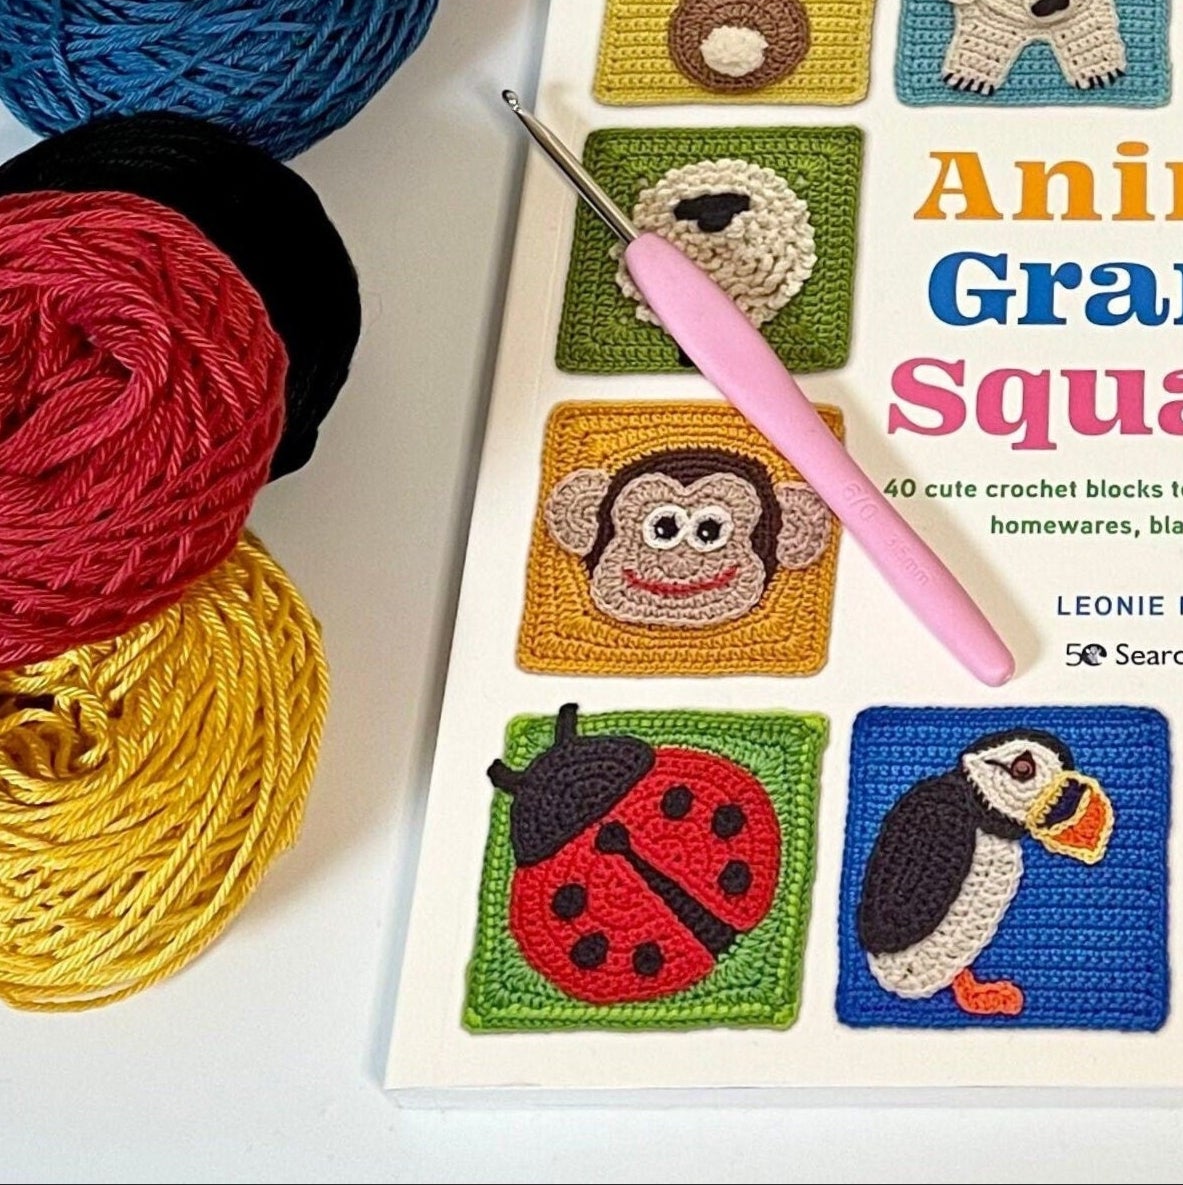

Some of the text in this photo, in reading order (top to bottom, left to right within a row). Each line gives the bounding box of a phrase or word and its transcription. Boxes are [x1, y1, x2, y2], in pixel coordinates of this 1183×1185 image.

[884, 478, 916, 498] 40
[925, 479, 977, 498] cute
[985, 478, 1077, 498] crochet
[1086, 478, 1163, 498] blocks
[990, 514, 1141, 538] homewares,
[1057, 595, 1165, 617] LEONIE
